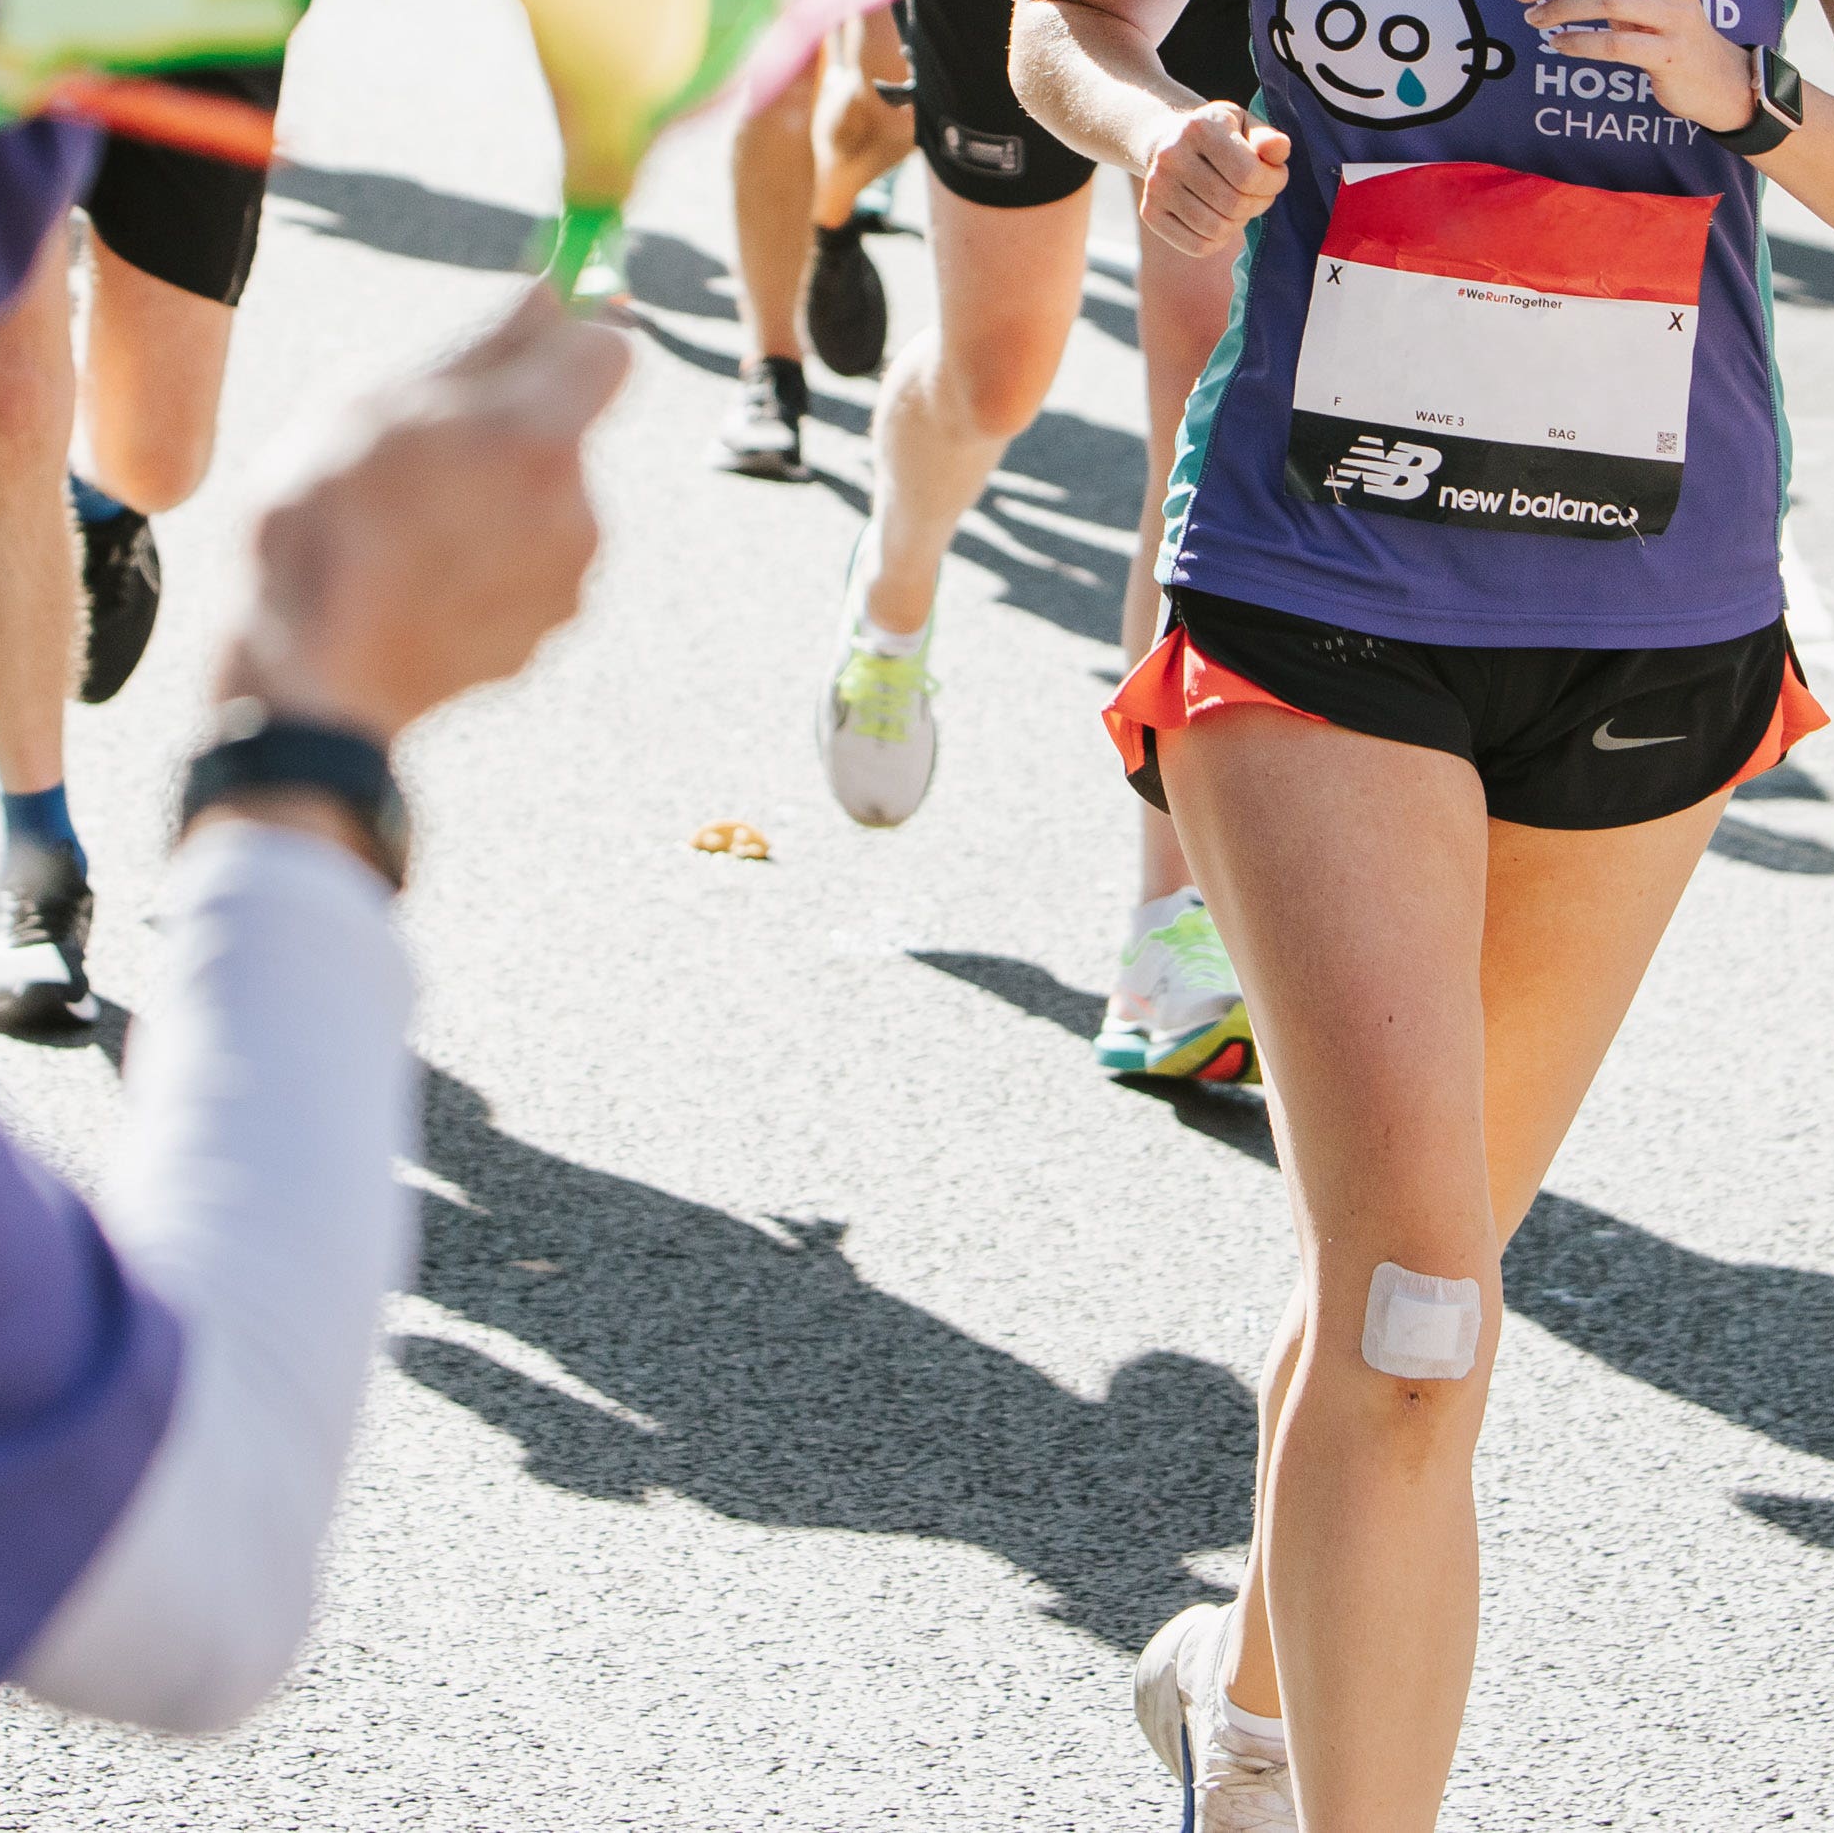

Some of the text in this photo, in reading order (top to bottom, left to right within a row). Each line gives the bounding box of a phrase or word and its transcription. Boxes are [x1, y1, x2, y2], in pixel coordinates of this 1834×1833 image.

[1535, 107, 1702, 146] CHARITY
[1326, 264, 1343, 285] X
[1457, 287, 1563, 310] #WeRunTogether
[1668, 311, 1685, 332] X
[1334, 396, 1342, 407] F
[1415, 410, 1465, 427] WAVE 3
[1548, 427, 1577, 441] BAG
[1438, 484, 1639, 528] new balance
